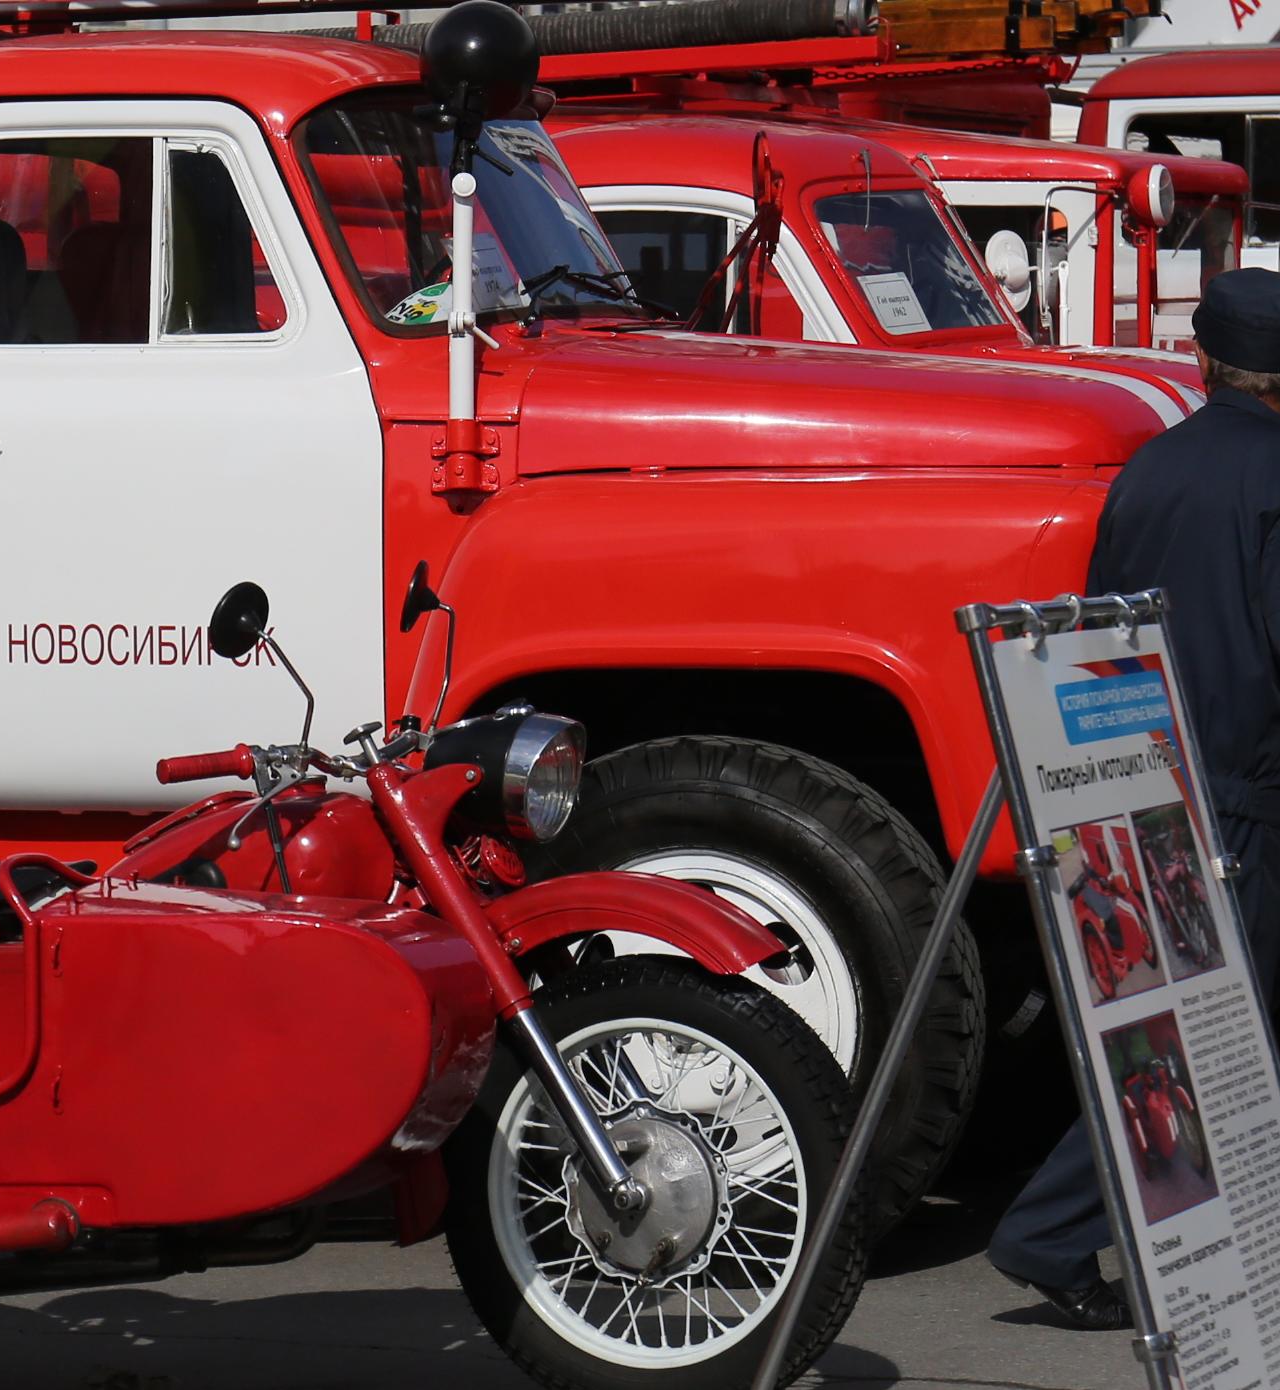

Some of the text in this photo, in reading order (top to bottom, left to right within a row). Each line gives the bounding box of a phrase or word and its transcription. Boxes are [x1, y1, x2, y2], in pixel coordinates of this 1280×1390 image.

[877, 295, 910, 304] Год выпуска
[892, 306, 907, 317] 1962
[1036, 757, 1098, 794] Пожарный
[1098, 753, 1145, 781] мотоцикл
